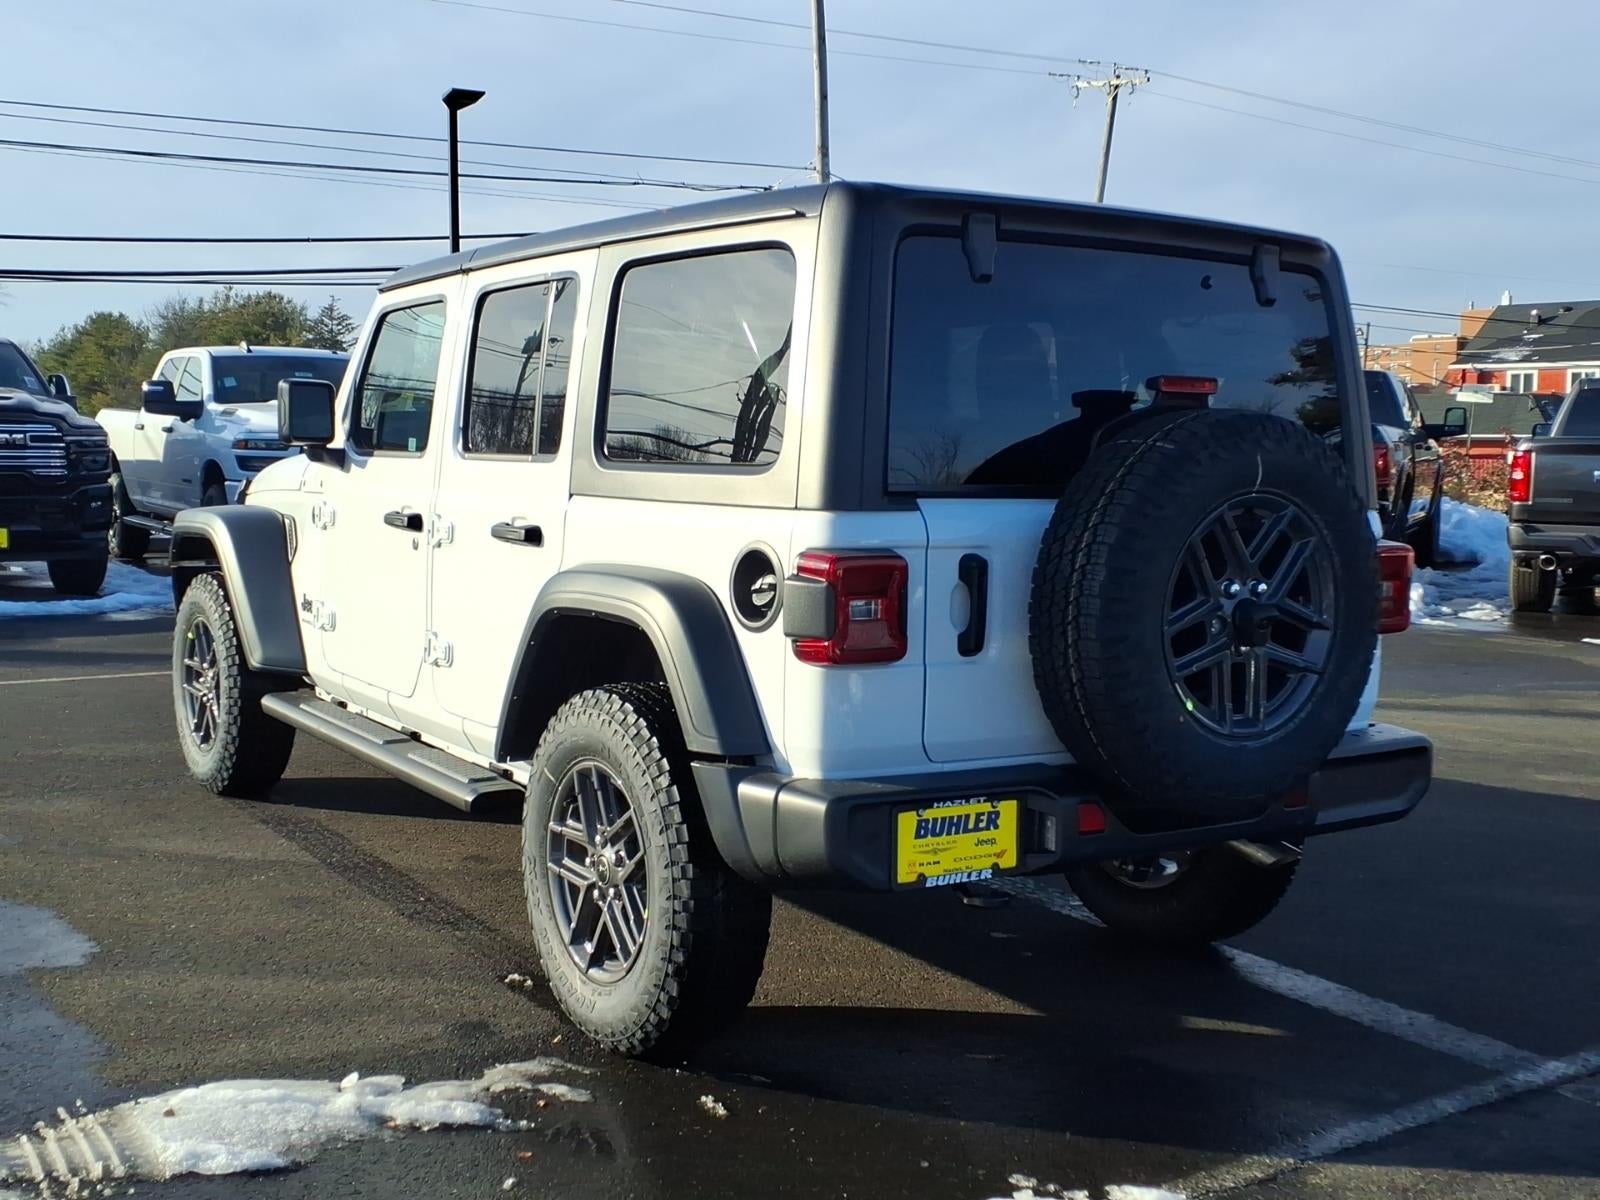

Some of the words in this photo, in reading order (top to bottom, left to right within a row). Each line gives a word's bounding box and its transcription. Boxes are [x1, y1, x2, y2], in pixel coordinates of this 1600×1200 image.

[933, 797, 988, 808] HAZLET
[914, 810, 1000, 840] BUHLER
[974, 837, 997, 847] Jeep
[926, 869, 993, 888] BUHLER
